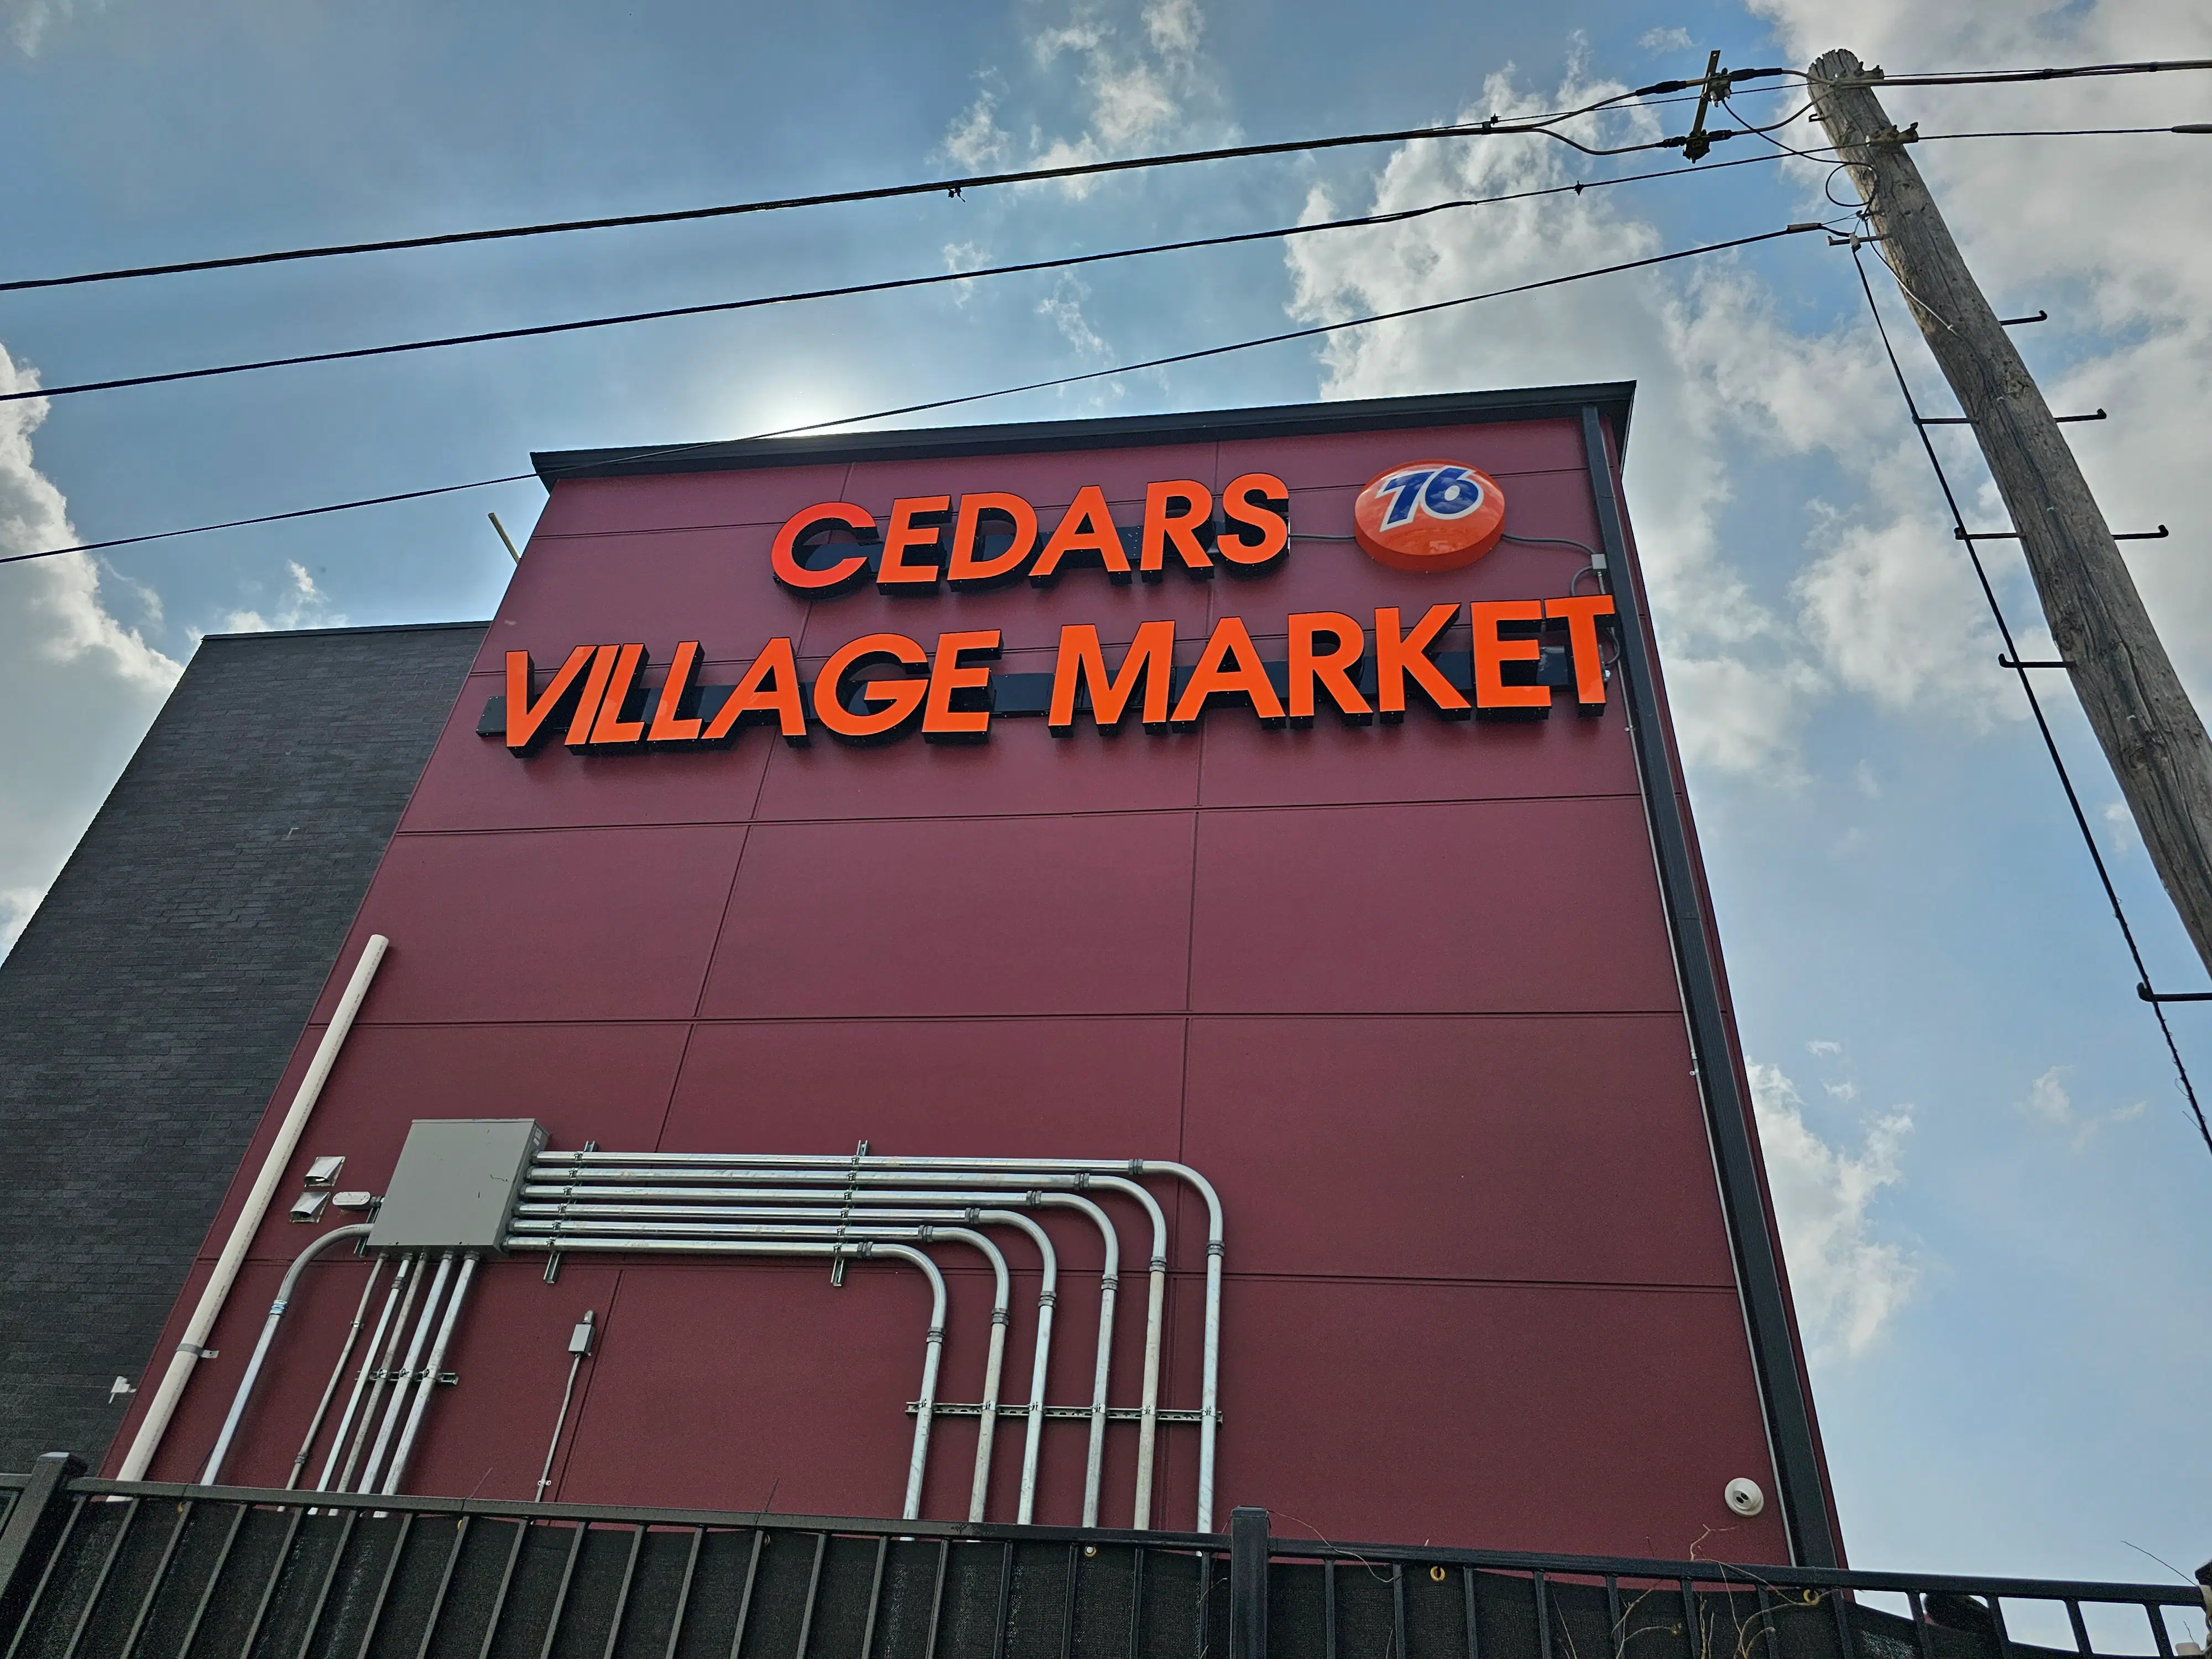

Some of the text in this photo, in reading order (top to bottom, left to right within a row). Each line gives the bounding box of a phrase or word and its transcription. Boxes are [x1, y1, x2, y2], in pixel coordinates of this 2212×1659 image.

[771, 474, 1287, 587] CEDARS
[1377, 465, 1484, 531] 76
[507, 594, 1615, 745] VILLAGE MARKET
